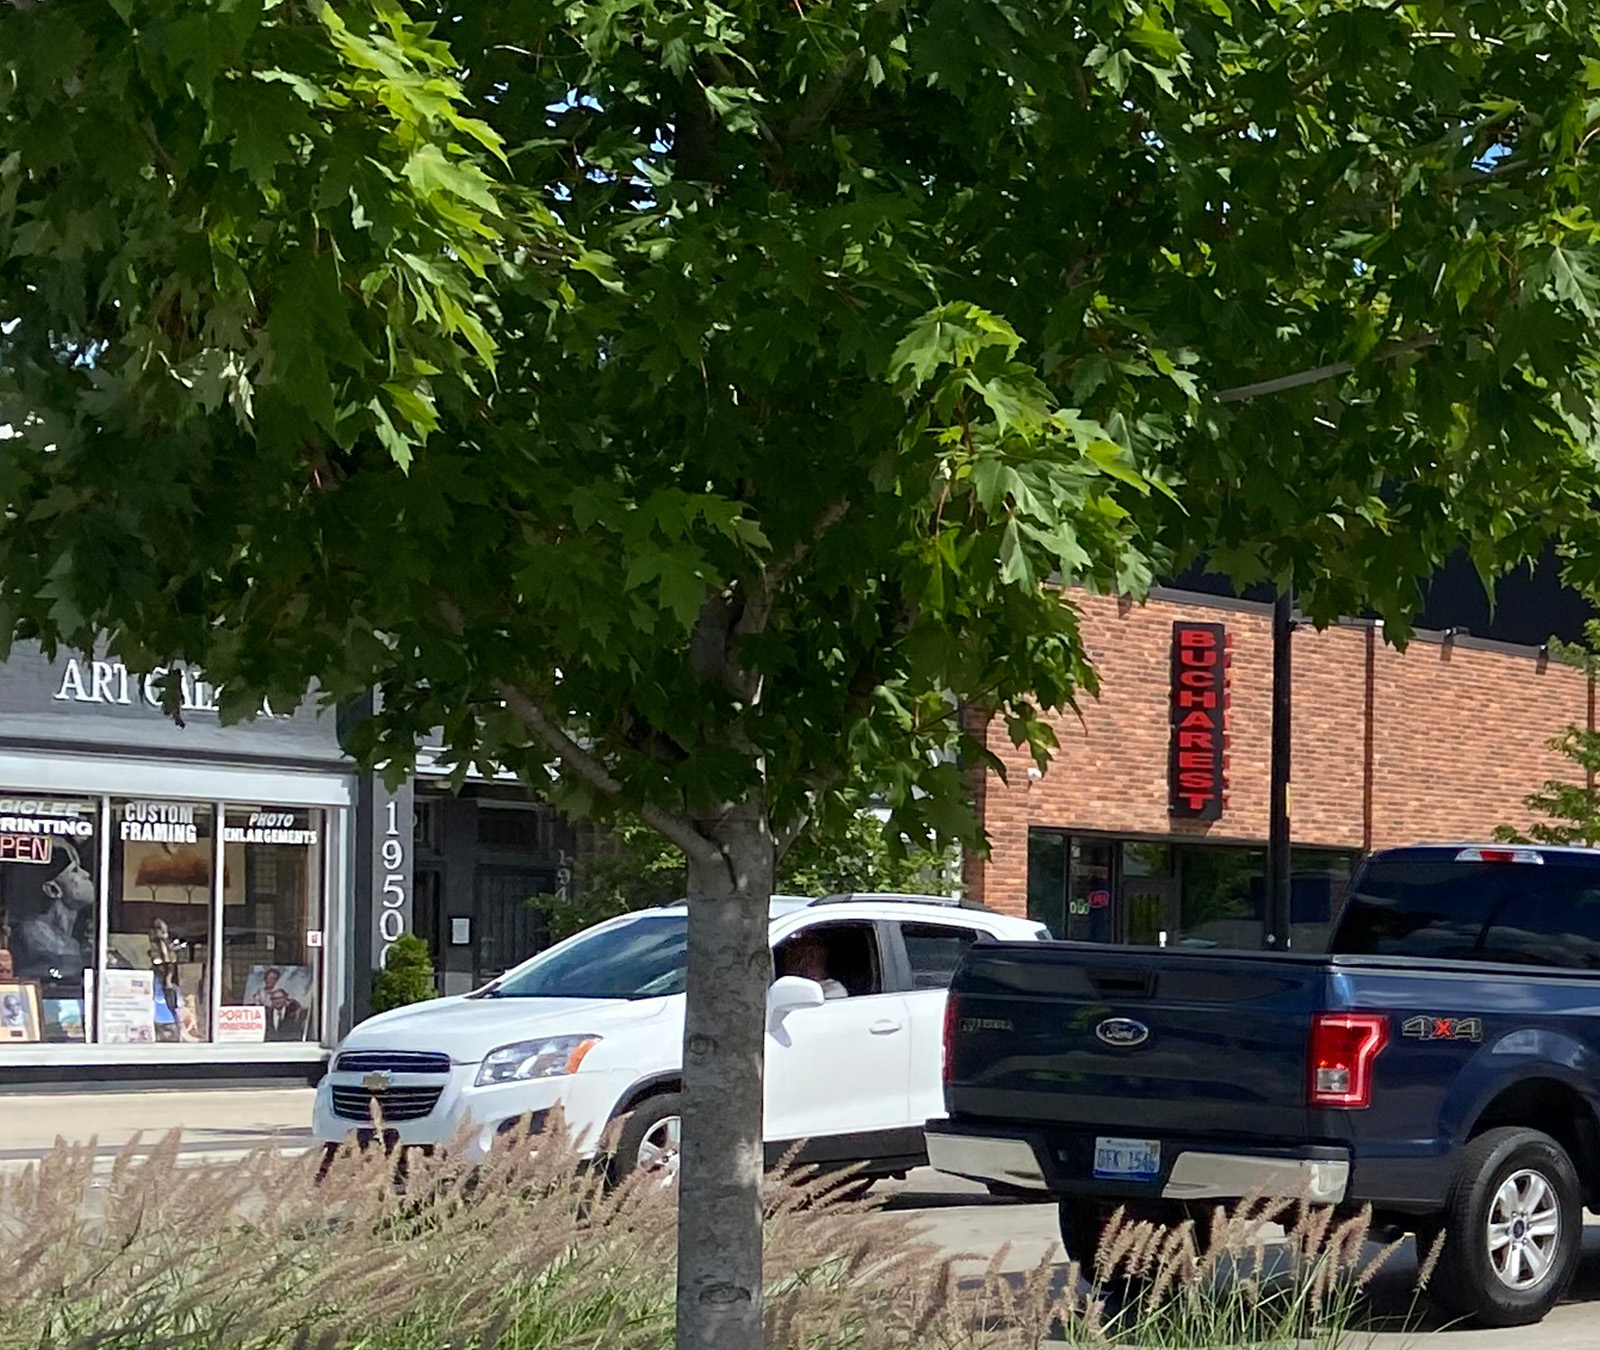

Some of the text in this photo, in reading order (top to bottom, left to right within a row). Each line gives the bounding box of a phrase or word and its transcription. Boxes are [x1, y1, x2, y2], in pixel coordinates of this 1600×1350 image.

[54, 658, 132, 705] ART
[1179, 630, 1217, 811] BUCHAREST
[124, 803, 194, 825] CUSTOM
[248, 812, 295, 828] PHOTO
[0, 817, 94, 836] RINTING
[121, 822, 198, 844] FRAMING
[223, 826, 318, 845] ENLARGEMENTS
[0, 836, 48, 861] PEN
